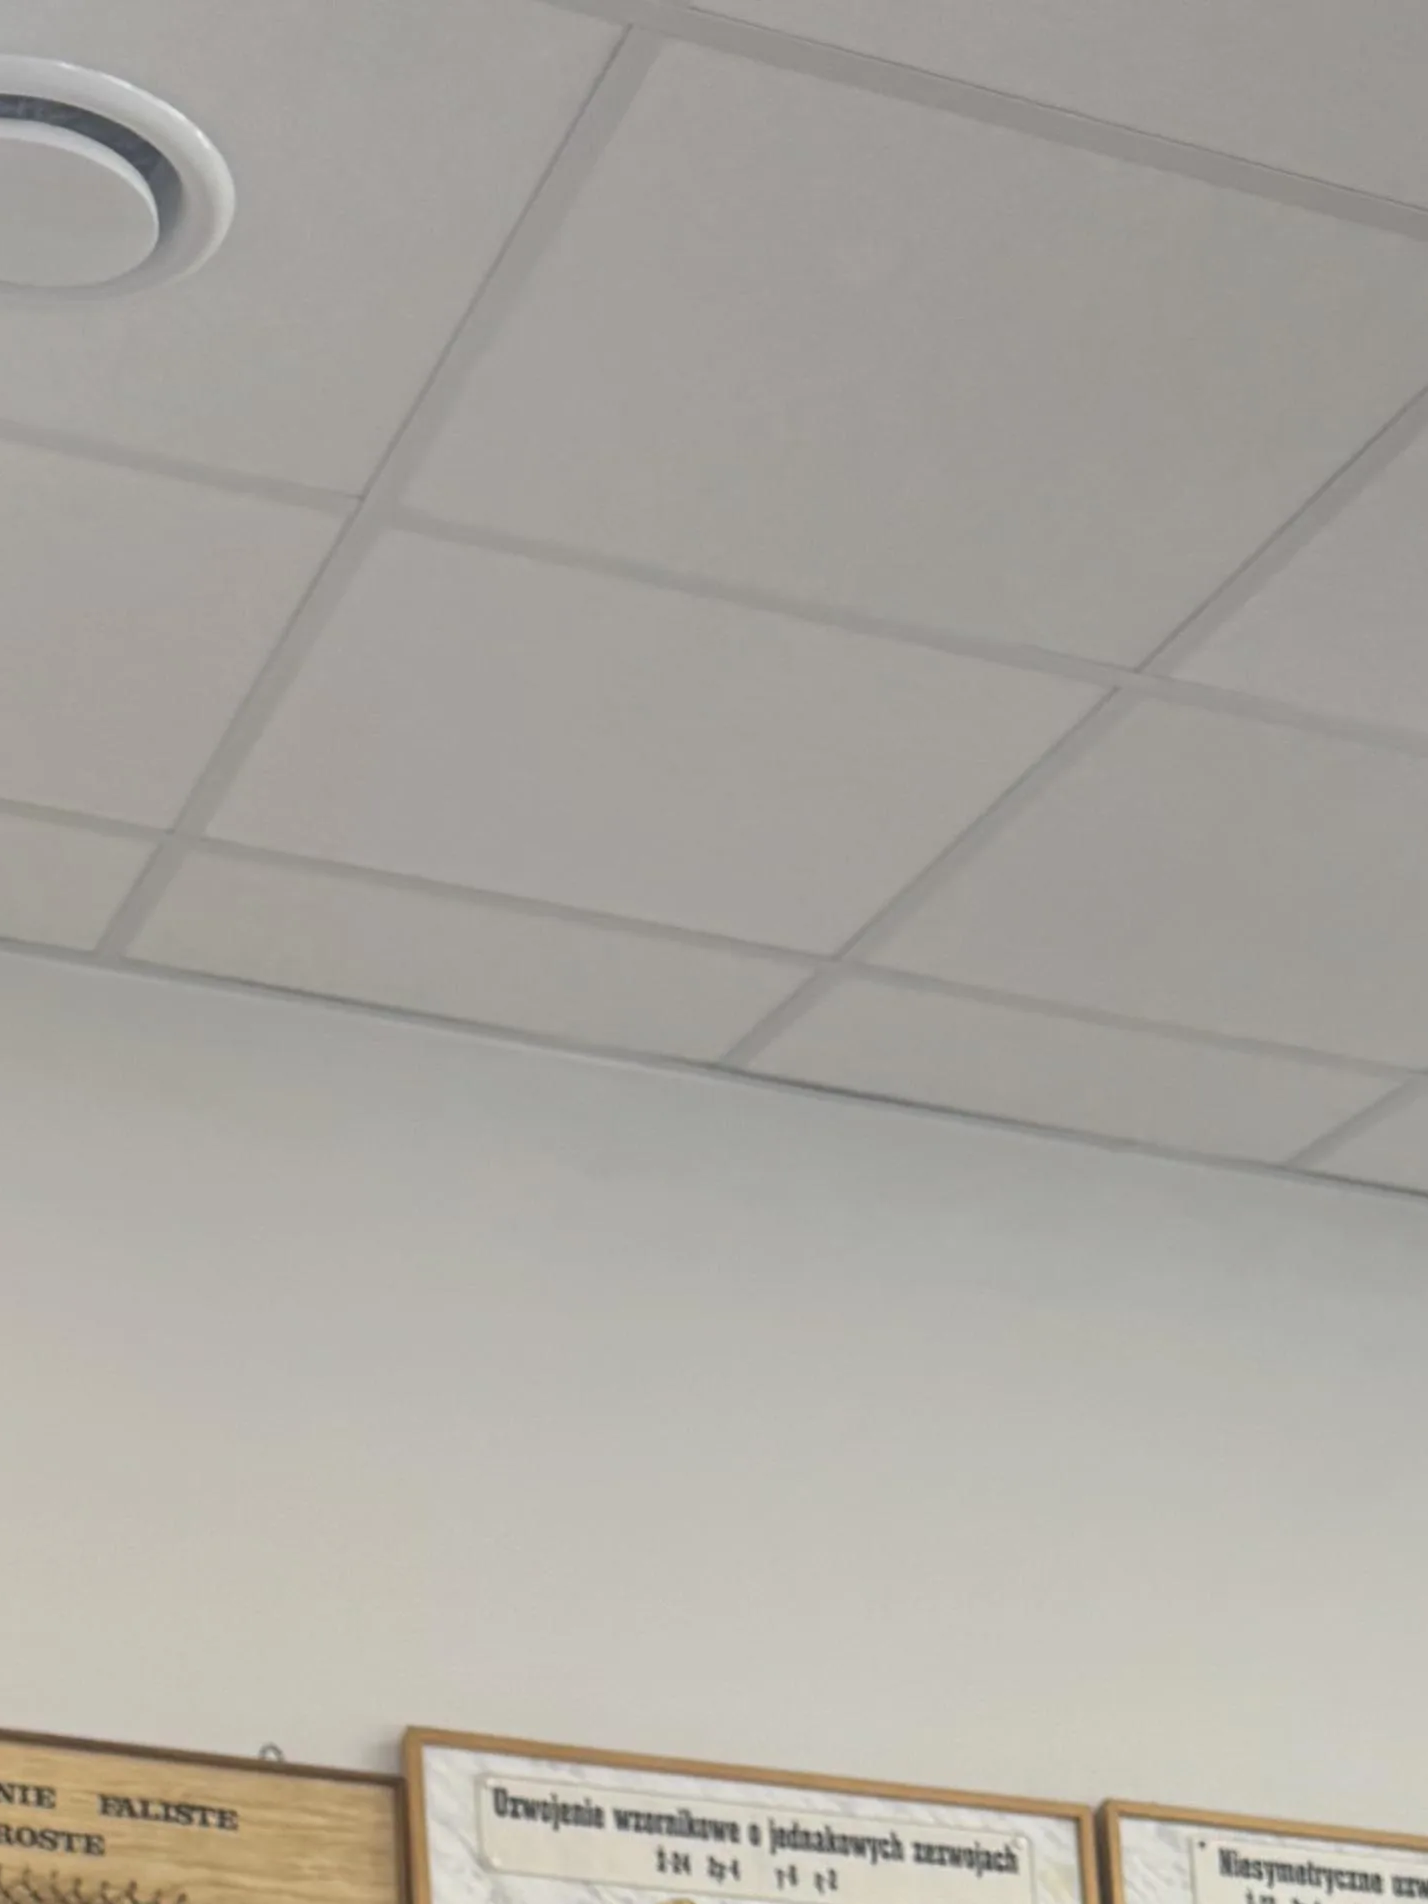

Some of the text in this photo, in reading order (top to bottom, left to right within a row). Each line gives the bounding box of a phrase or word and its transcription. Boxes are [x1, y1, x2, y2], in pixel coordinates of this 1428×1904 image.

[97, 1793, 239, 1832] FALISTE
[493, 1786, 605, 1832] Uzwojenie
[768, 1817, 905, 1866] jednakowych
[912, 1840, 1020, 1879] zezwojach
[1218, 1847, 1384, 1895] Niesymetryczne
